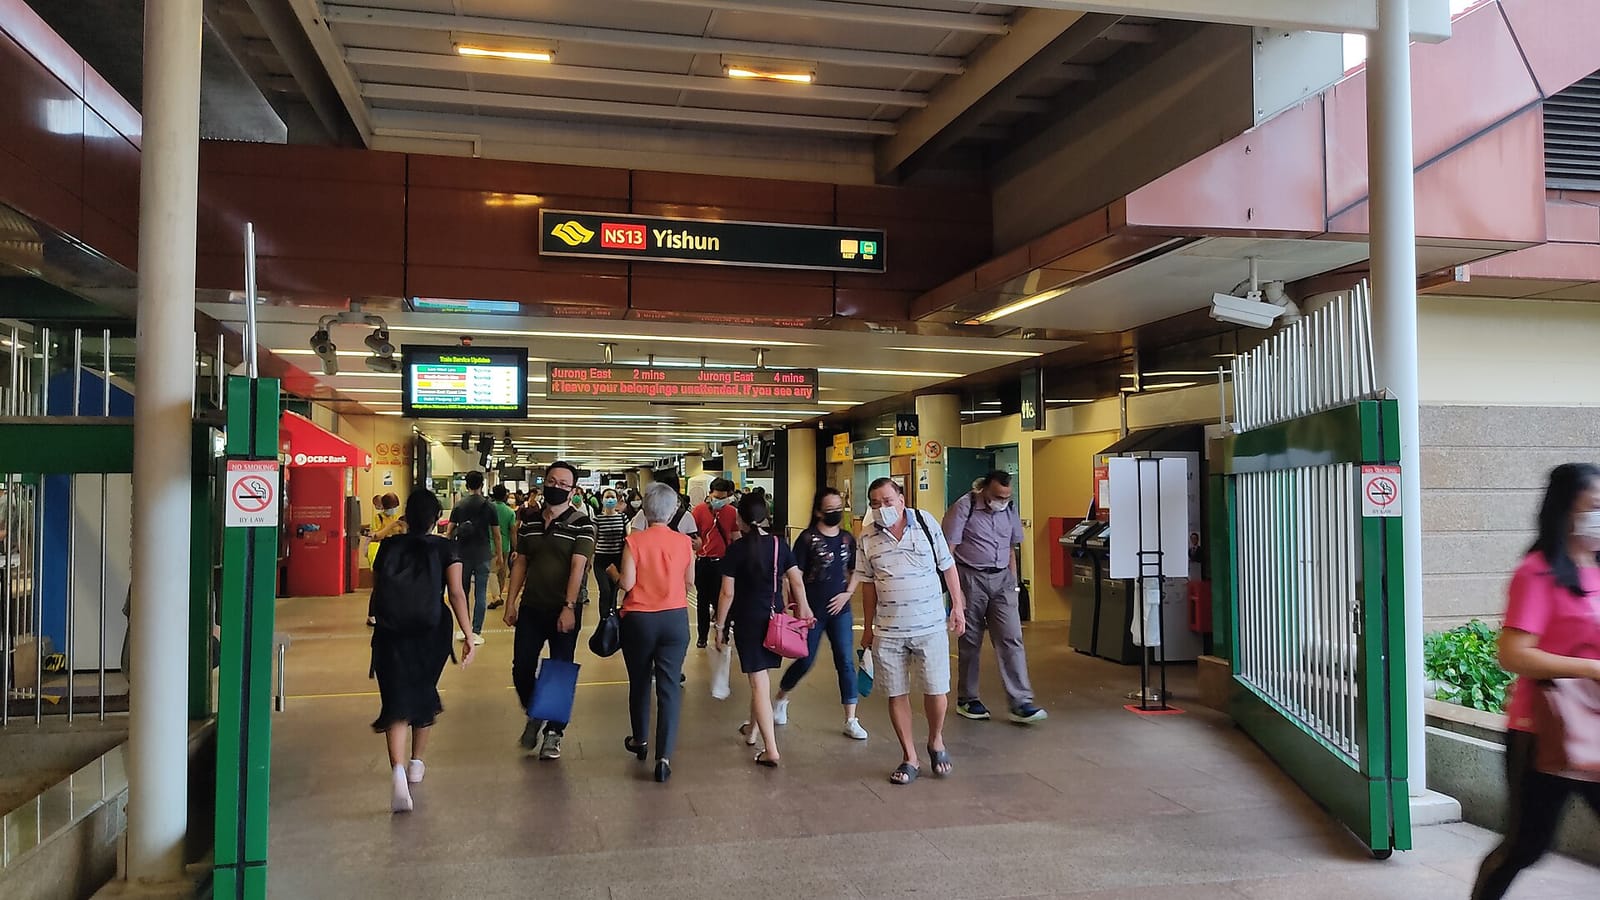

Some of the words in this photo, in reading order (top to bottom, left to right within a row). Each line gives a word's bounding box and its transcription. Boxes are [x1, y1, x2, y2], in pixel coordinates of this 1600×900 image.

[605, 230, 643, 245] NS13
[653, 229, 720, 251] Yishun
[552, 368, 587, 380] Jurong
[590, 368, 612, 379] East
[633, 369, 639, 380] 2
[642, 370, 665, 380] mins
[698, 371, 731, 383] Jurong
[734, 372, 754, 382] East
[774, 372, 780, 383] 4
[782, 373, 805, 383] mins
[561, 382, 590, 392] leave
[592, 384, 618, 395] your
[620, 382, 678, 396] belongings
[743, 385, 752, 395] If
[752, 386, 772, 398] you
[774, 387, 792, 396] see
[794, 388, 813, 399] any
[307, 455, 328, 463] OCBC
[329, 455, 347, 463] Bank
